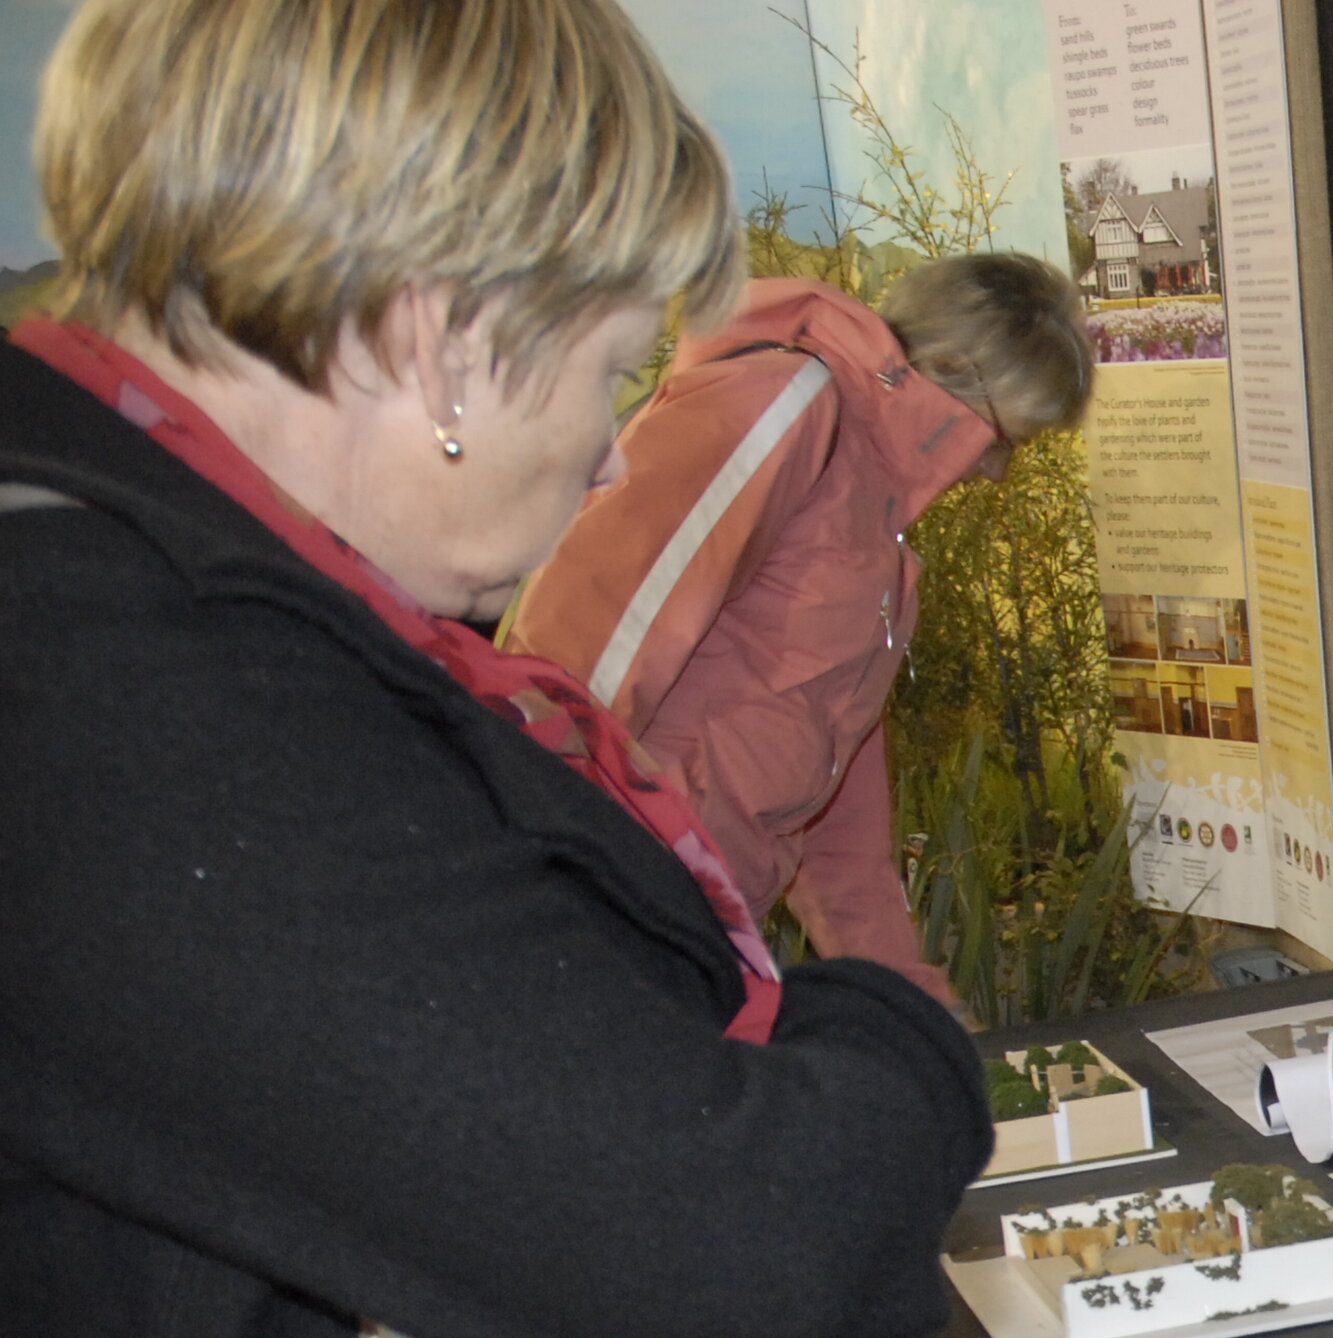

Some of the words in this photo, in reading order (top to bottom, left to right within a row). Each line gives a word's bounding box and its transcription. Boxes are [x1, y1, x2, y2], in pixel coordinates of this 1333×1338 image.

[1061, 34, 1078, 45] sand
[1079, 31, 1094, 42] hills
[1127, 41, 1151, 53] flower
[1153, 38, 1172, 50] beds
[1090, 49, 1108, 59] beds
[1130, 58, 1168, 72] deciduous
[1170, 56, 1189, 66] trees
[1131, 78, 1155, 91] colour
[1133, 97, 1158, 110] design
[1090, 104, 1109, 118] grass
[1135, 114, 1169, 126] formality
[1169, 398, 1182, 408] and
[1184, 398, 1210, 410] garden
[1119, 417, 1130, 425] the
[1132, 416, 1147, 426] love
[1148, 414, 1155, 425] of
[1158, 416, 1180, 427] plants
[1182, 414, 1196, 425] and
[1099, 435, 1135, 447] gardening
[1136, 433, 1156, 443] which
[1159, 435, 1176, 443] were
[1178, 433, 1193, 444] part
[1194, 431, 1202, 442] of
[1100, 451, 1112, 460] the
[1114, 451, 1137, 460] culture
[1139, 451, 1151, 460] the
[1153, 451, 1179, 460] settlers
[1181, 450, 1211, 463] brought
[1115, 493, 1131, 506] keep
[1133, 494, 1152, 504] them
[1153, 495, 1168, 507] part
[1170, 493, 1177, 504] of
[1116, 530, 1133, 538] value
[1135, 530, 1146, 538] our
[1148, 530, 1177, 541] heritage
[1179, 530, 1212, 542] buildings
[1117, 545, 1129, 554] and
[1159, 563, 1189, 576] heritage
[1191, 564, 1229, 575] protectors
